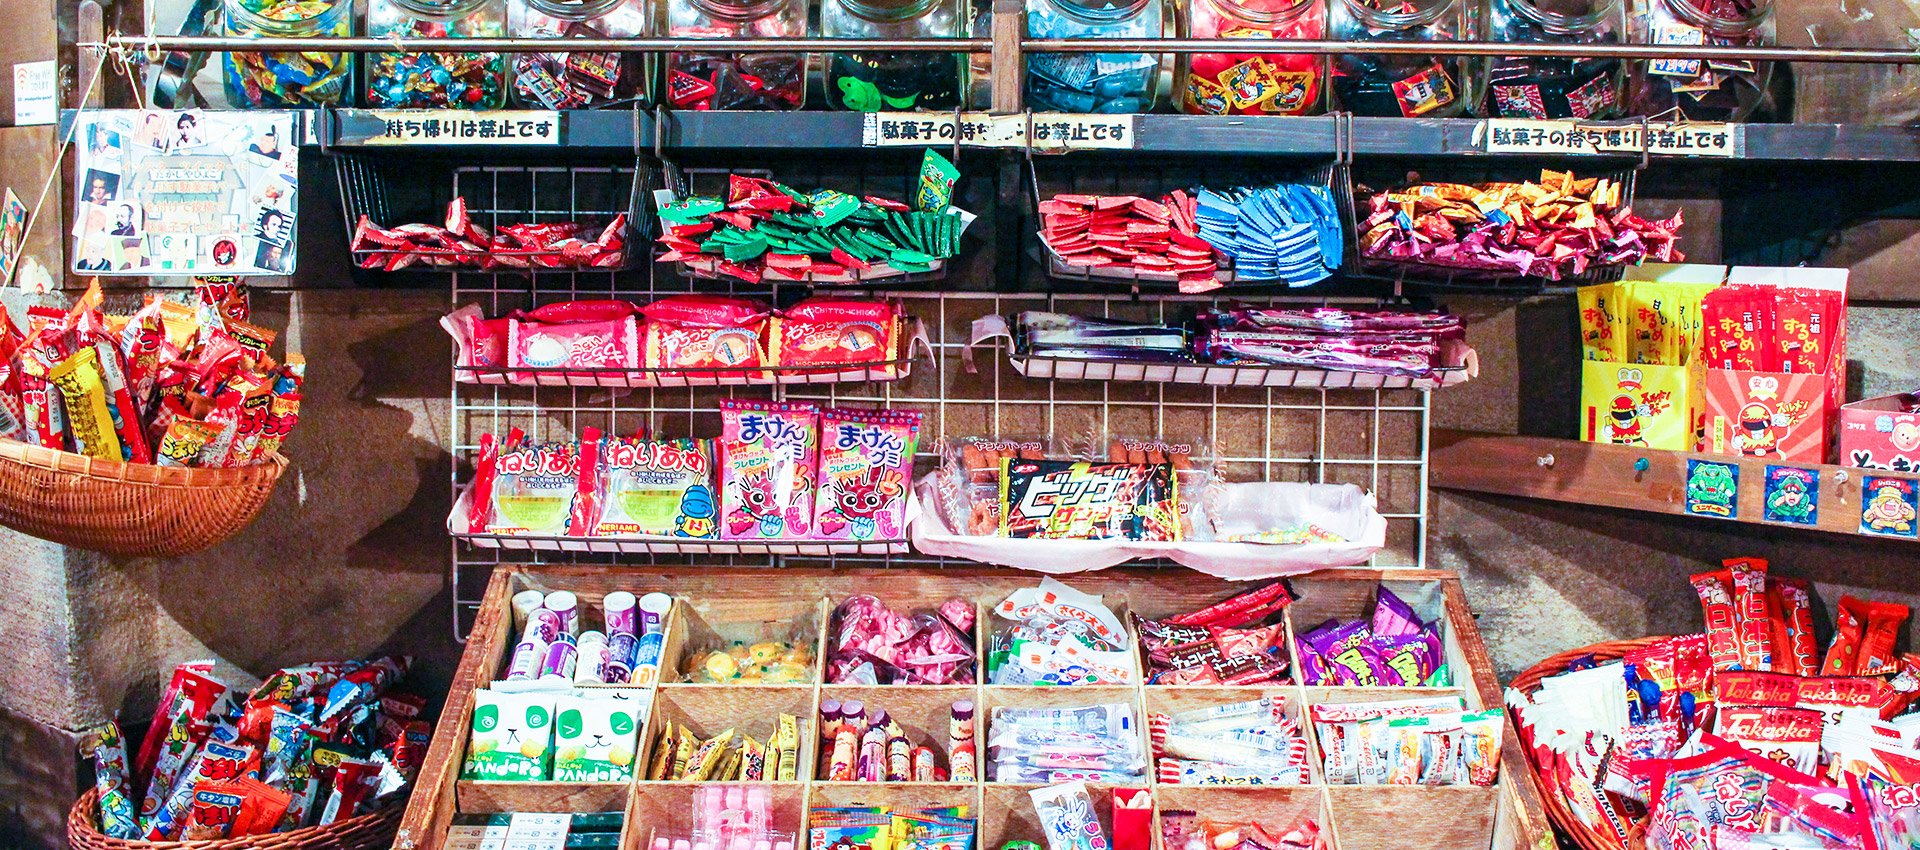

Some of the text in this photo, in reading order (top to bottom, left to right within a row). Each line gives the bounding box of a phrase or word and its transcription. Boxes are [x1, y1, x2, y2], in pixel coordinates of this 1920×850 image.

[385, 119, 553, 138] 持ち帰りは禁止です
[881, 120, 1126, 141] 駄菓子の持ちは禁止です
[1493, 128, 1729, 149] 駄菓子の持ち帰りは禁止です
[740, 414, 806, 442] まけん
[838, 425, 902, 451] まけん
[609, 442, 706, 474] ねりあめ
[871, 450, 898, 465] グミ
[1727, 678, 1792, 703] Takaoka
[1728, 713, 1811, 738] Takaoka
